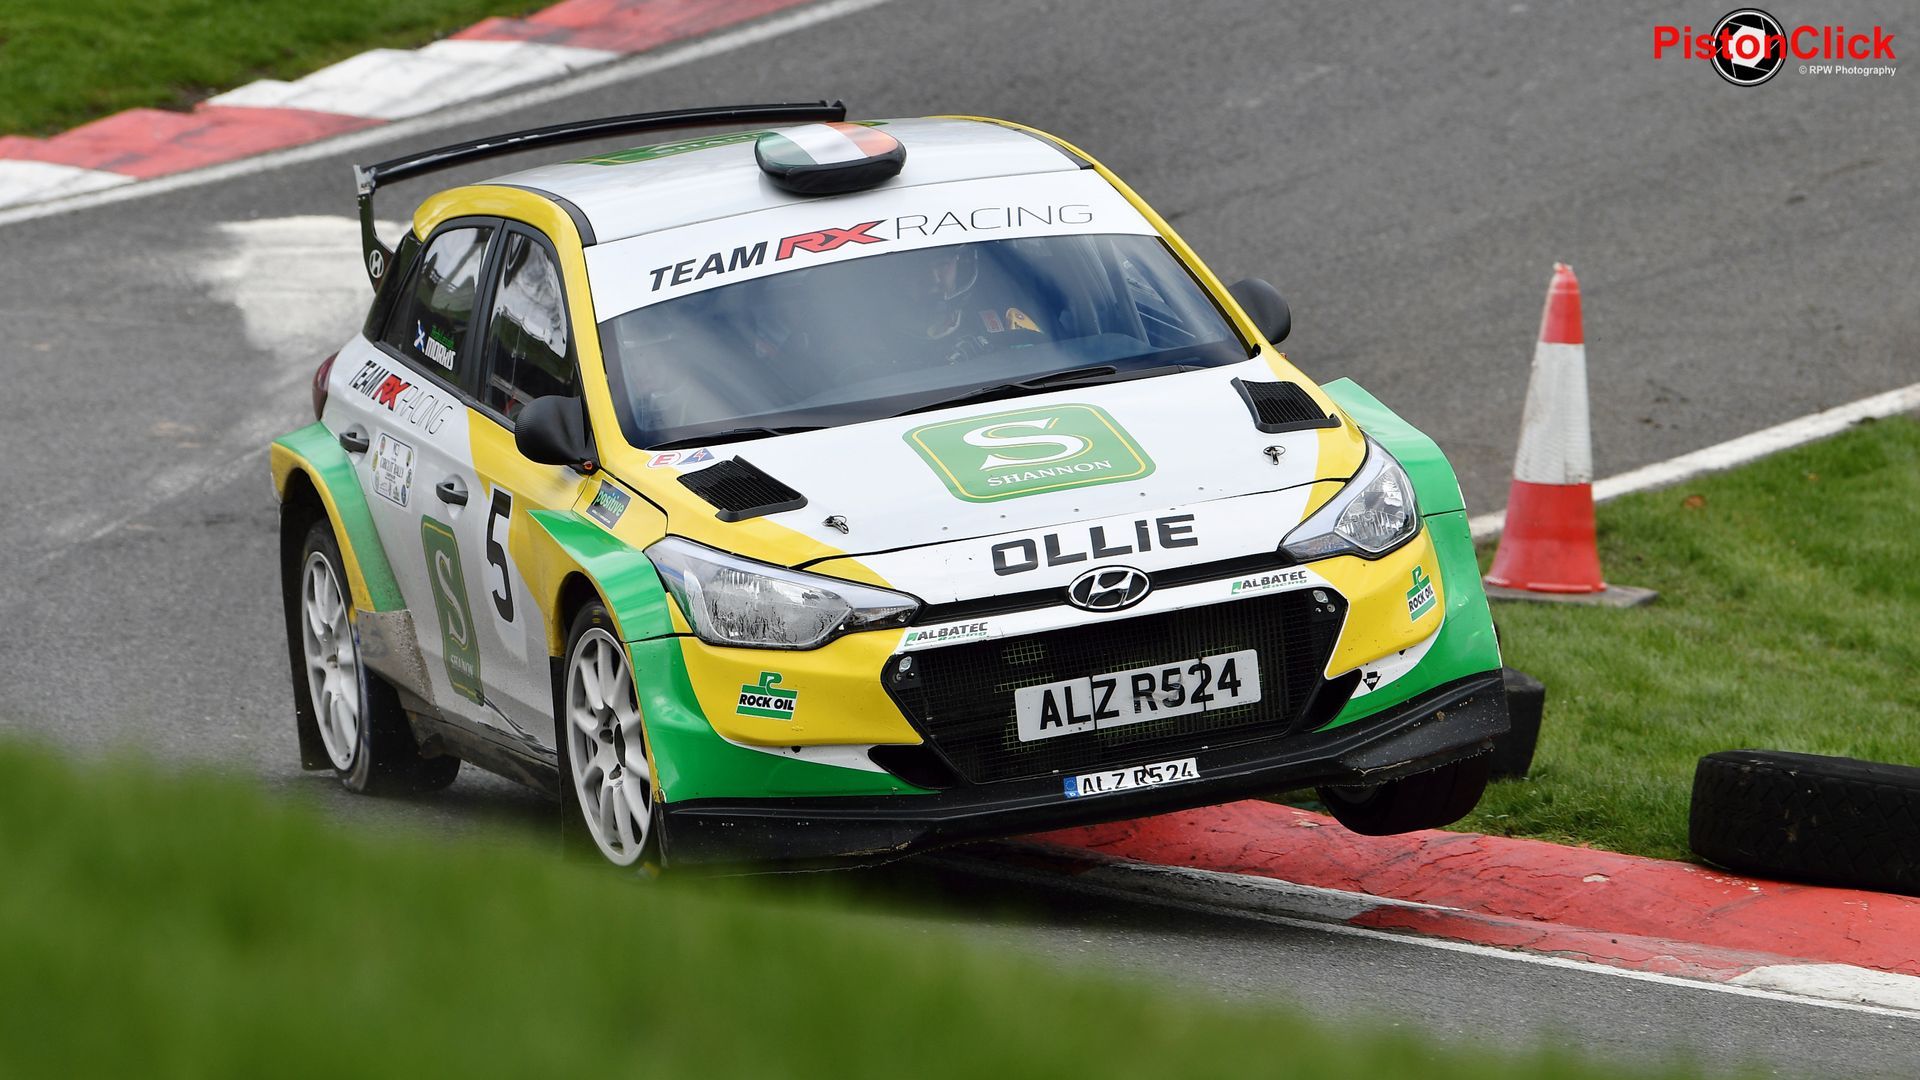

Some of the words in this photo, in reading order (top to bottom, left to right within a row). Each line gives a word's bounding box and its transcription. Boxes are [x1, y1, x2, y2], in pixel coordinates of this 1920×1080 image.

[649, 241, 768, 292] TEAM
[775, 218, 889, 262] RX
[896, 204, 1094, 240] RACING
[348, 359, 390, 397] TEAM
[371, 374, 412, 412] RX
[395, 385, 453, 434] RACING
[987, 459, 1112, 487] SHANNON
[593, 490, 625, 517] positive
[487, 488, 514, 623] 5
[991, 514, 1198, 576] OLLIE
[1242, 570, 1307, 589] ALBATEC
[1408, 591, 1426, 613] ROCK
[917, 622, 988, 641] ALBATEC
[739, 693, 772, 708] ROCK
[774, 698, 794, 711] OIL
[1039, 680, 1120, 731] ALZ
[1131, 658, 1242, 714] R524
[1083, 772, 1129, 793] ALZ
[1134, 762, 1194, 786] R524
